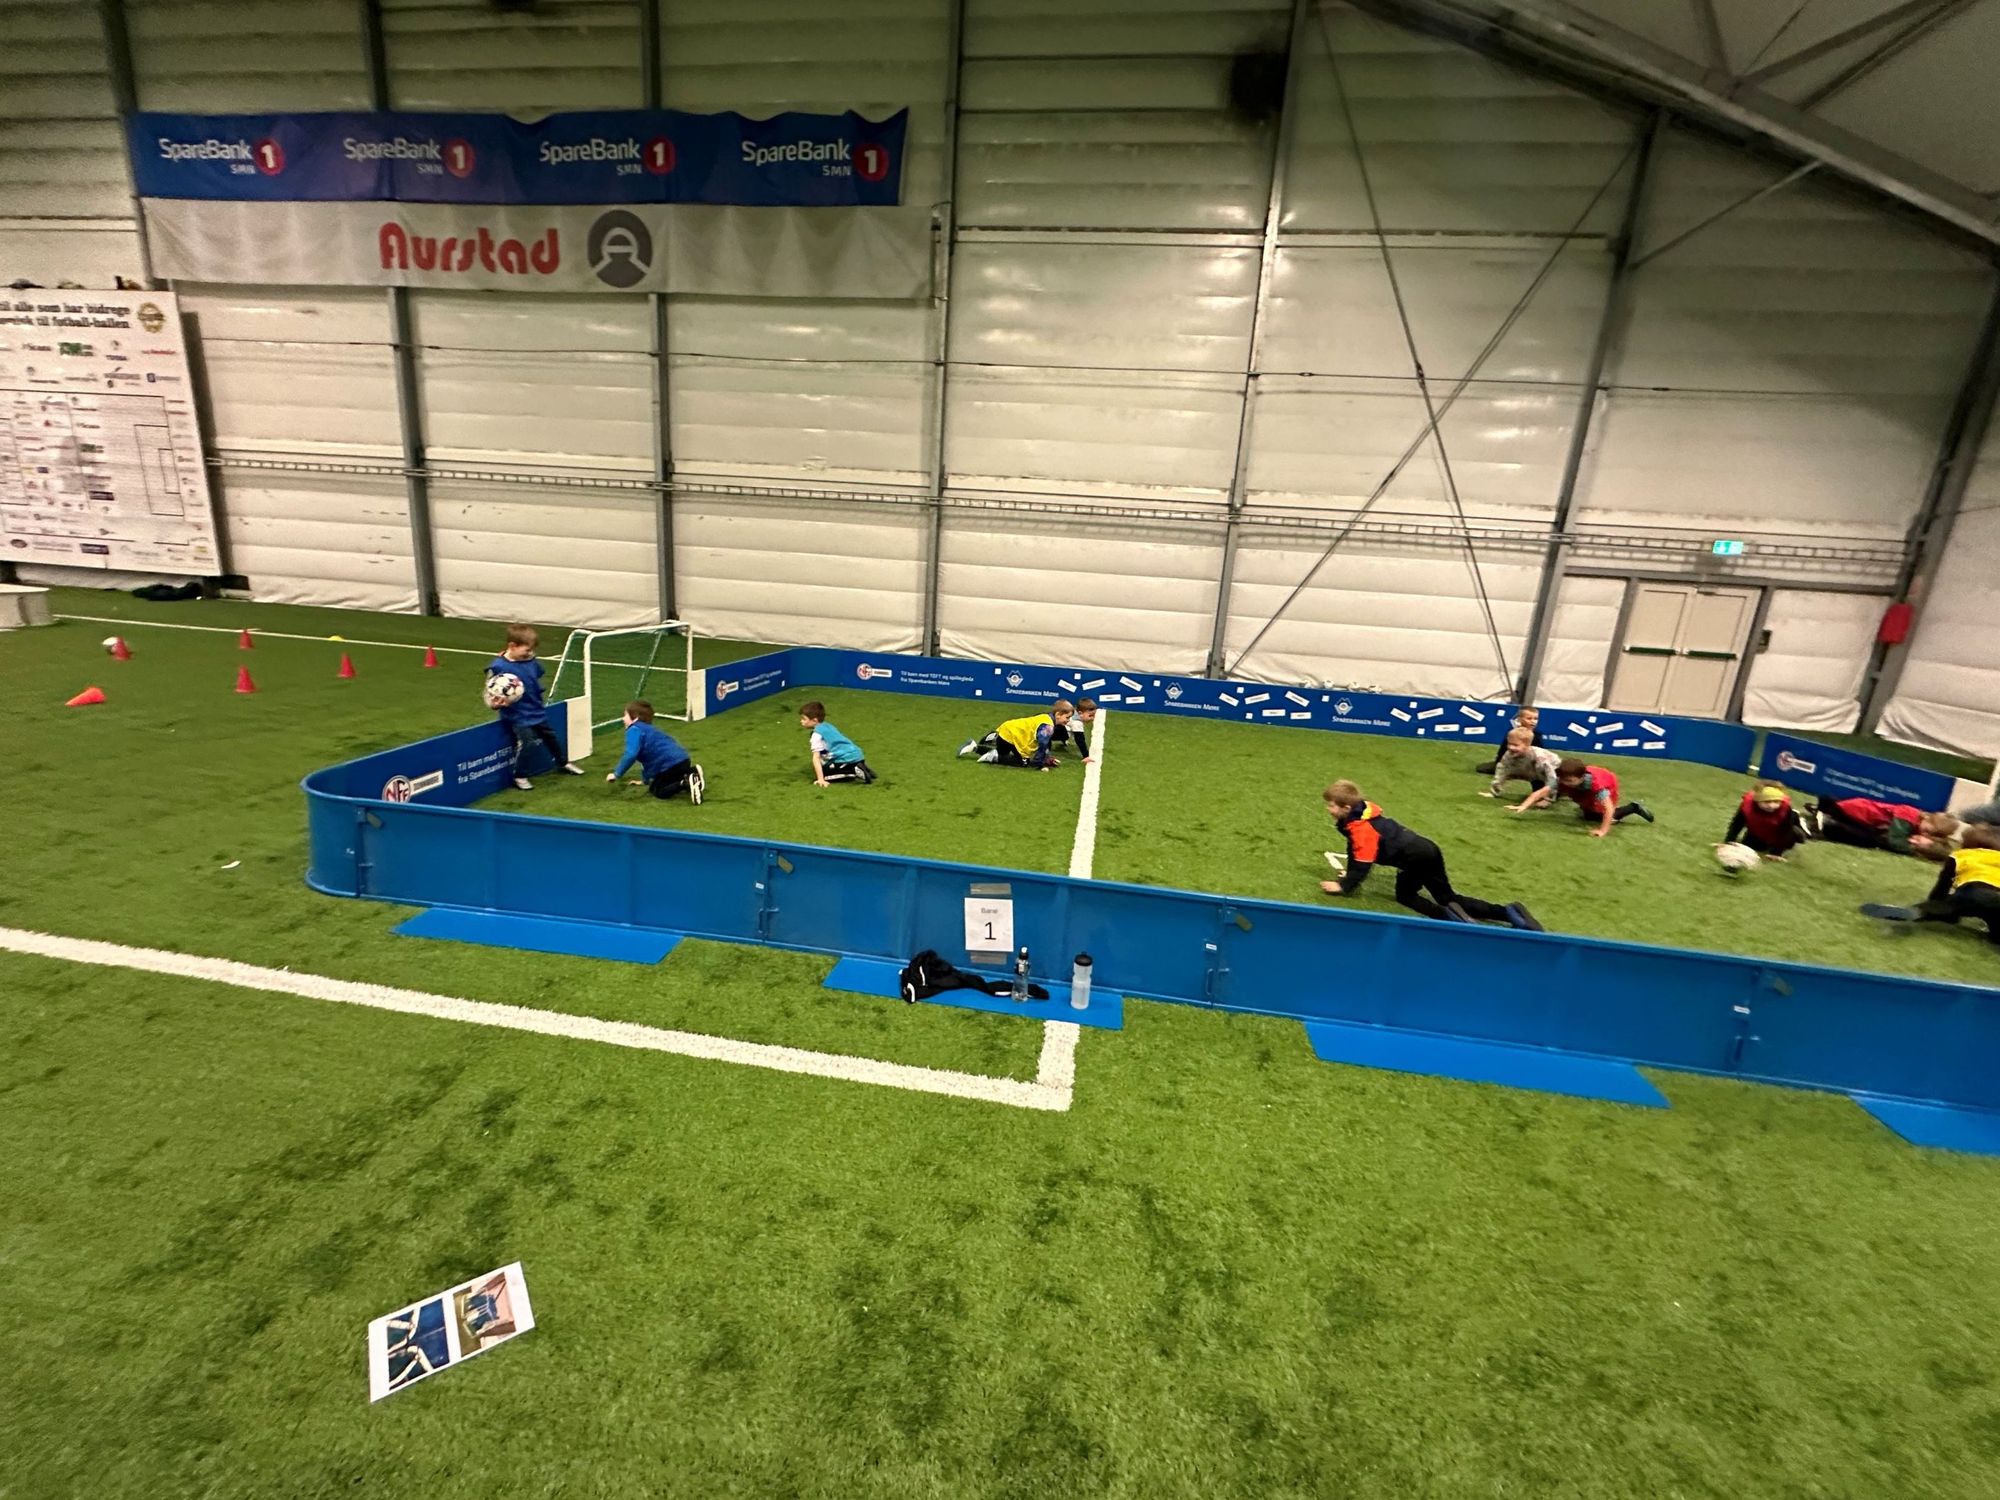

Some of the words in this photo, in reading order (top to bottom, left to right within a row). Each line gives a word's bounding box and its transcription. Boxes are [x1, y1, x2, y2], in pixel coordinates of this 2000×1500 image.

[159, 138, 253, 162] SpareBank
[261, 144, 275, 169] 1
[343, 137, 441, 162] SpareBank
[453, 145, 465, 170] 1
[540, 137, 640, 165] SpareBank
[653, 142, 664, 167] 1
[741, 138, 850, 166] SpareBank
[864, 149, 877, 174] 1
[230, 164, 256, 174] SMN
[416, 163, 443, 174] SMN
[616, 163, 642, 175] SMN
[822, 165, 850, 176] SMN
[379, 222, 560, 275] Aurstad
[37, 304, 61, 313] som
[63, 302, 83, 313] har
[36, 315, 49, 326] til
[483, 751, 497, 763] med
[457, 775, 469, 784] fra
[984, 921, 997, 940] 1
